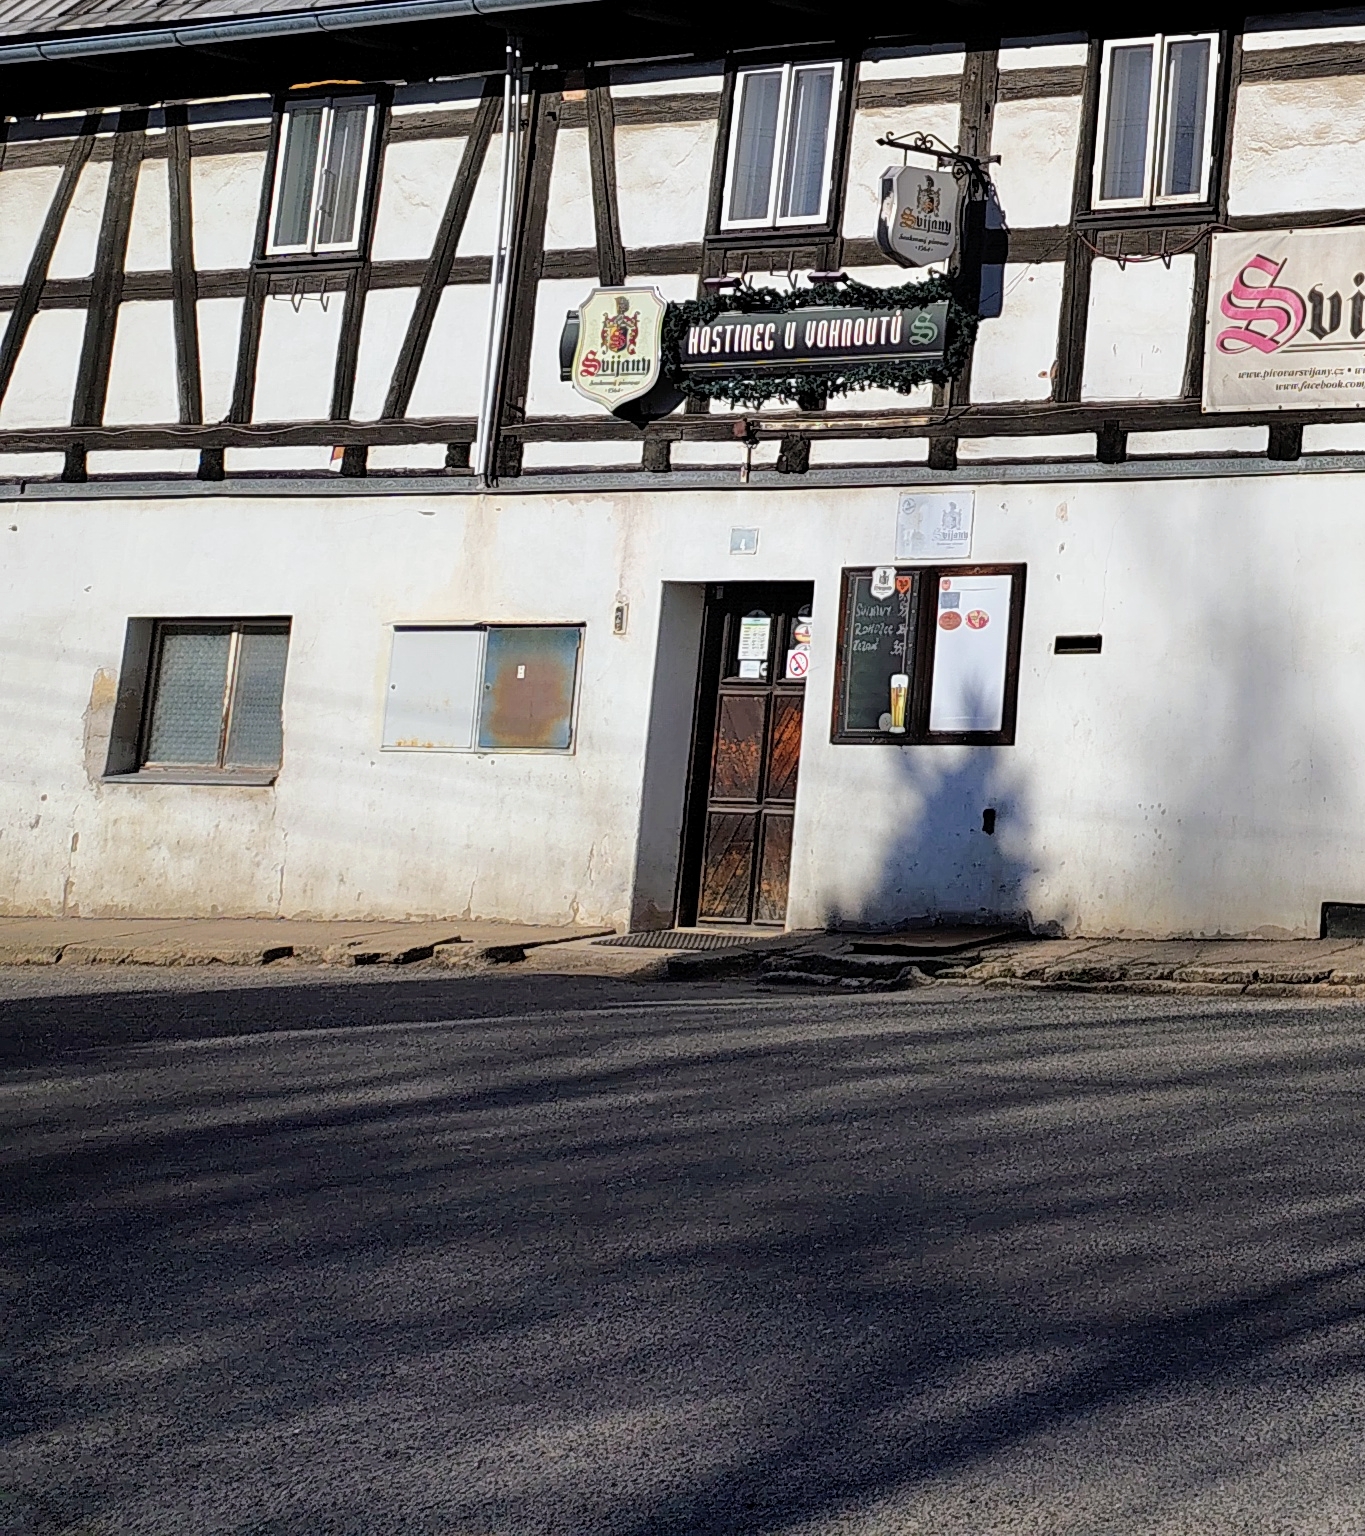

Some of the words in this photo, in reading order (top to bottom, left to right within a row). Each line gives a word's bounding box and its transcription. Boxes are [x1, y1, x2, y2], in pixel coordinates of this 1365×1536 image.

[900, 207, 952, 235] Svijany
[687, 322, 775, 355] HOSTINEC
[784, 321, 797, 349] U
[580, 350, 651, 377] Svijany
[1237, 367, 1345, 380] www.pivovarsvijany.cz
